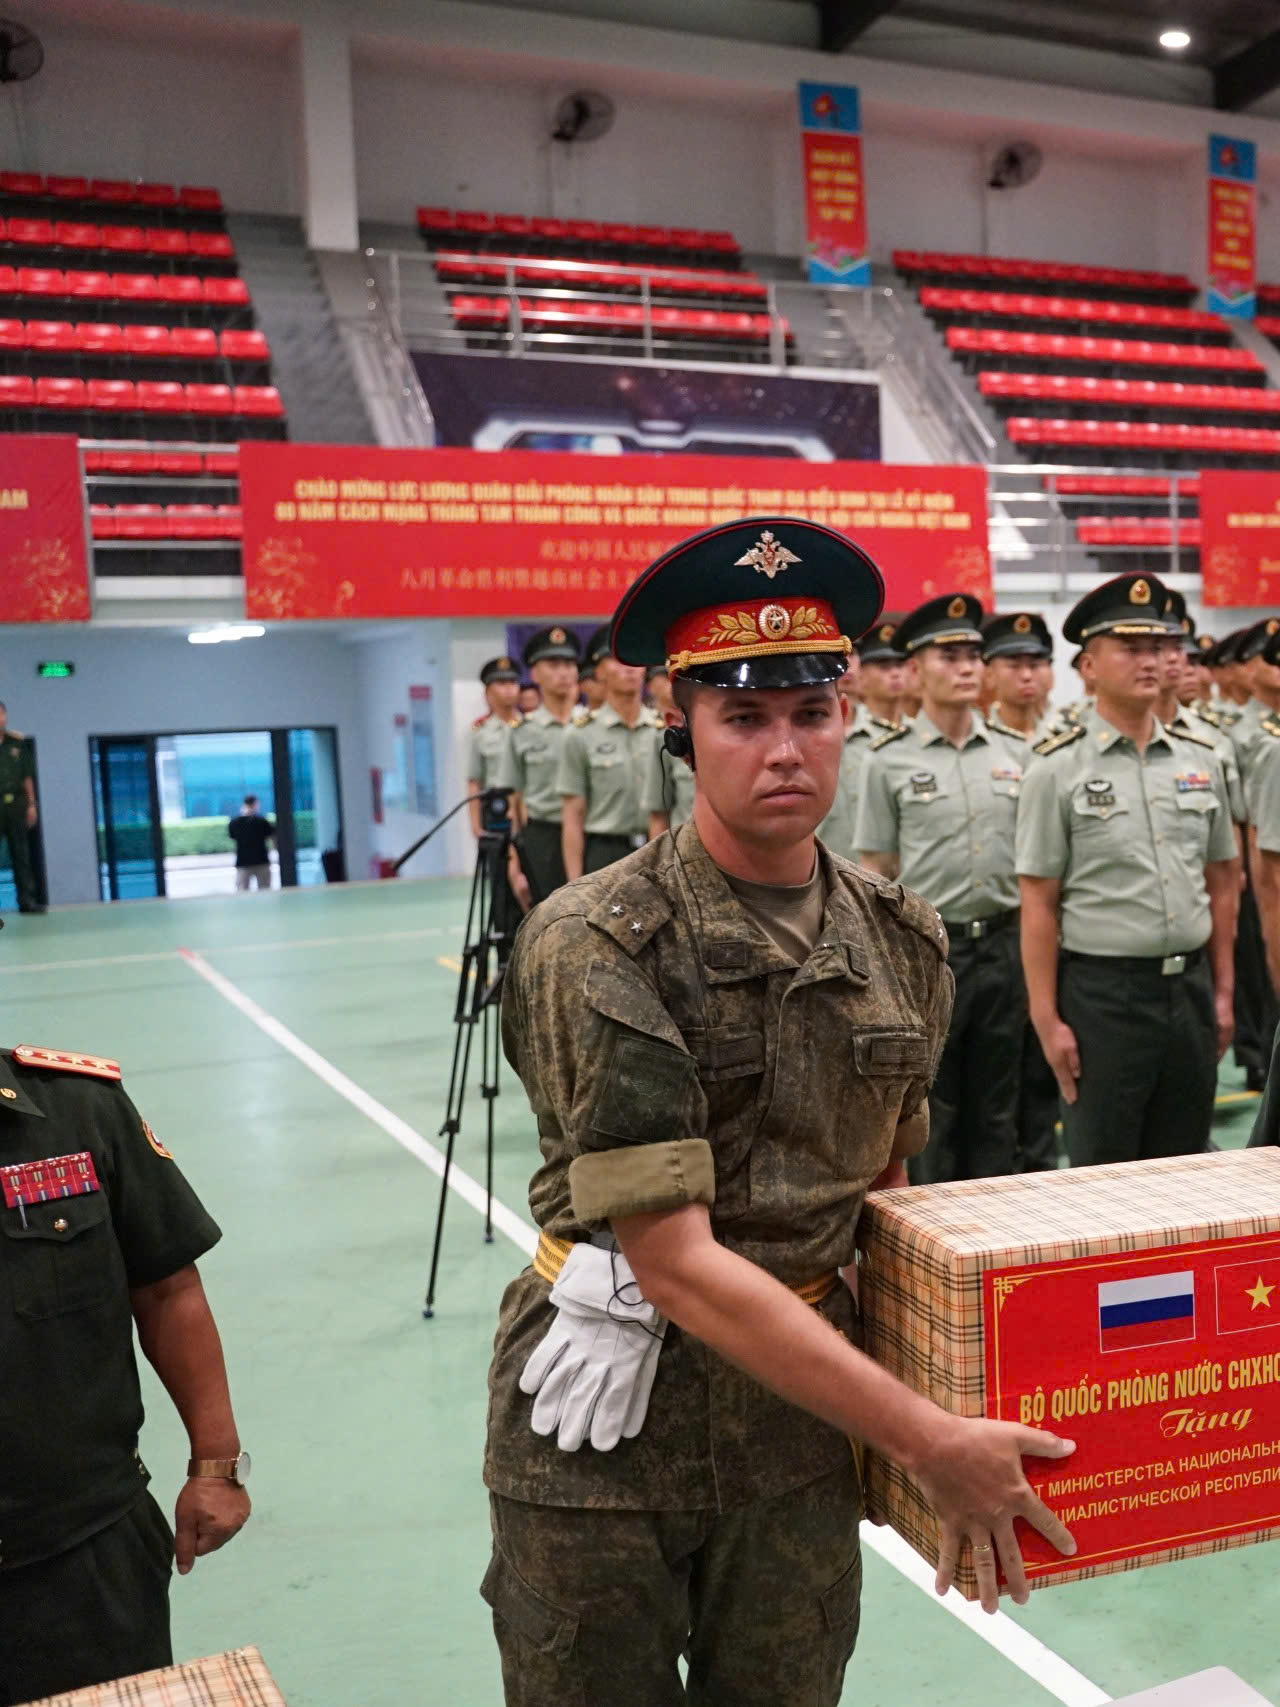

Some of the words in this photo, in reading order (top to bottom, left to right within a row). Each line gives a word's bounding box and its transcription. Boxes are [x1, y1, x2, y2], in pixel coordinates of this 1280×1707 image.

[1020, 1386, 1045, 1428] BỘ
[1051, 1374, 1101, 1422] QUỐC
[1107, 1369, 1169, 1411] PHÒNG
[1174, 1359, 1222, 1399] NƯỚC
[1160, 1407, 1255, 1438] Tặng
[1048, 1460, 1175, 1498] МИНИСТЕРСТВА
[1055, 1480, 1201, 1526] ЦИАЛИСТИЧЕСКОЙ
